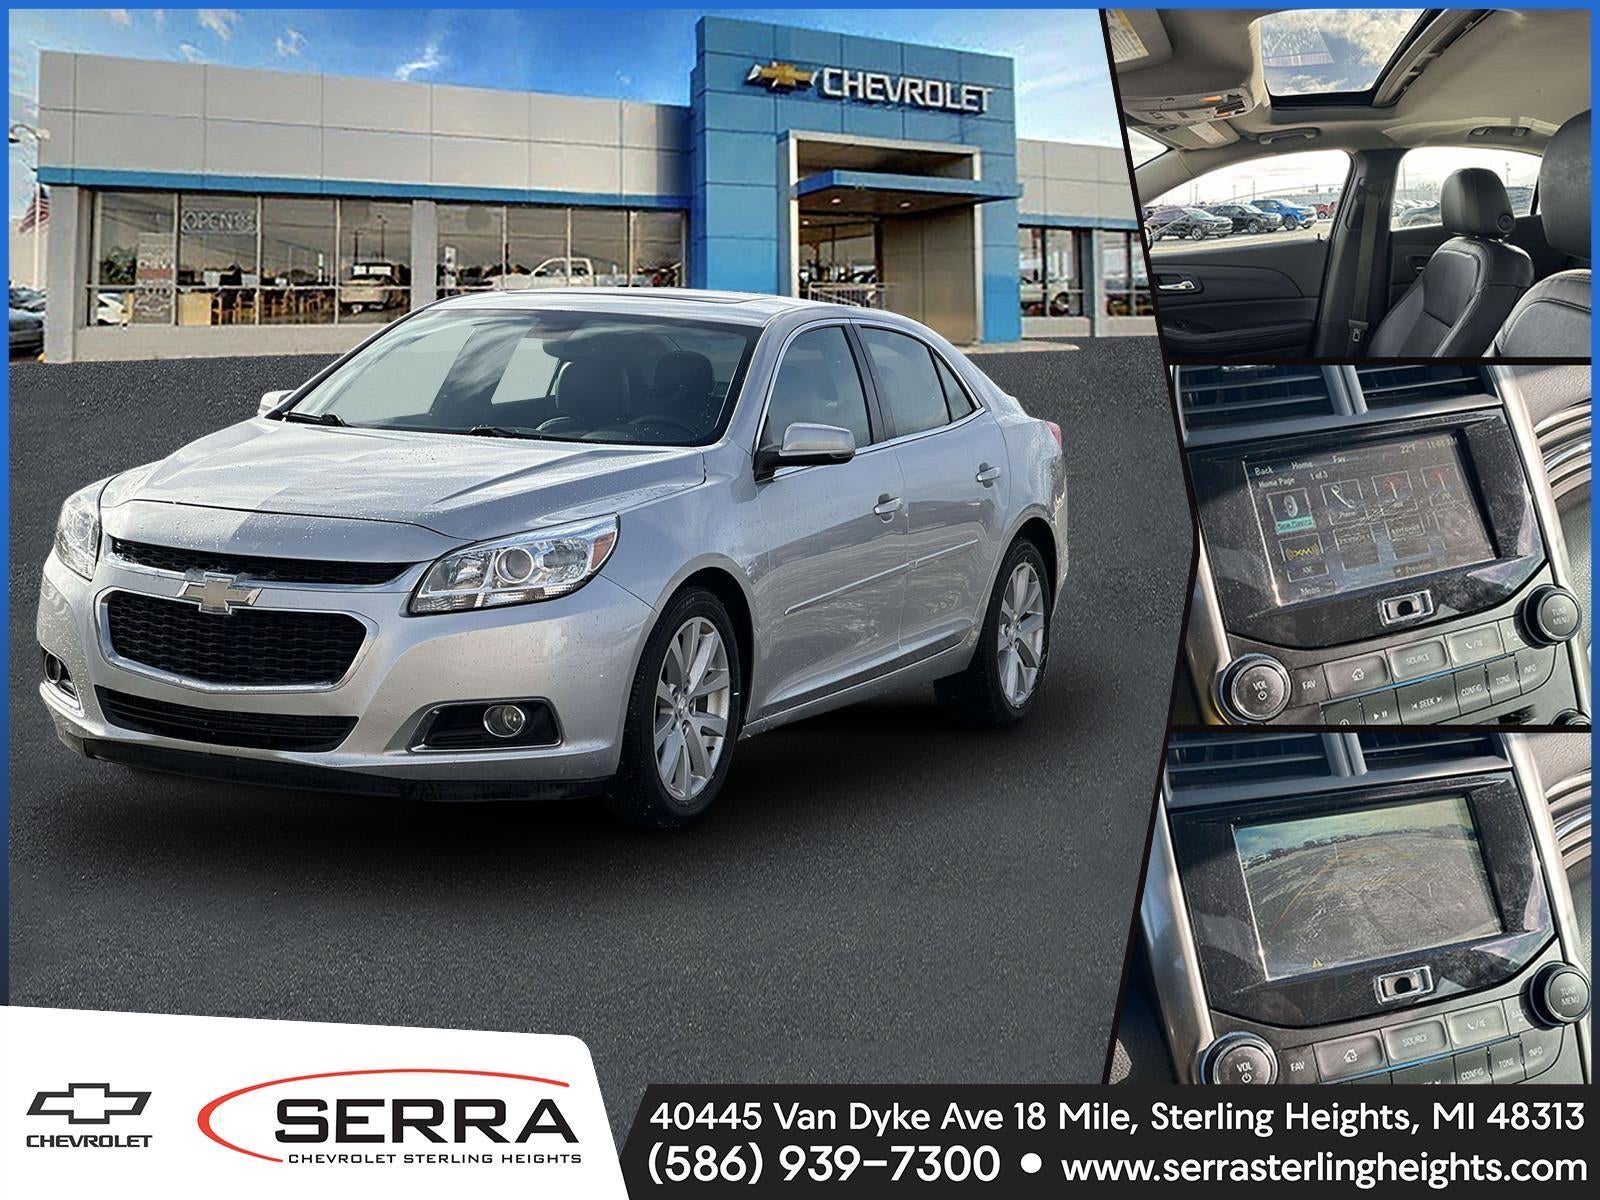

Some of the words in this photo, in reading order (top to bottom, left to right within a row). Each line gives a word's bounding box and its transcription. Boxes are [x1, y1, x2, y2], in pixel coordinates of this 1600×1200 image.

[822, 67, 993, 111] CHEVROLET
[1254, 466, 1274, 476] Back
[1291, 461, 1314, 470] Home
[1259, 480, 1278, 488] Home
[1278, 477, 1295, 487] Page
[1406, 653, 1429, 665] SOURCE
[1253, 680, 1267, 690] VOL
[1302, 680, 1316, 689] FAV
[1461, 683, 1482, 696] CONFIG
[1419, 697, 1436, 709] SEEK
[1402, 1034, 1428, 1047] SOURCE
[1237, 1060, 1253, 1073] VOL
[1291, 1061, 1305, 1072] FAV
[1499, 1057, 1514, 1069] TONE
[1461, 1067, 1484, 1080] CONFIG
